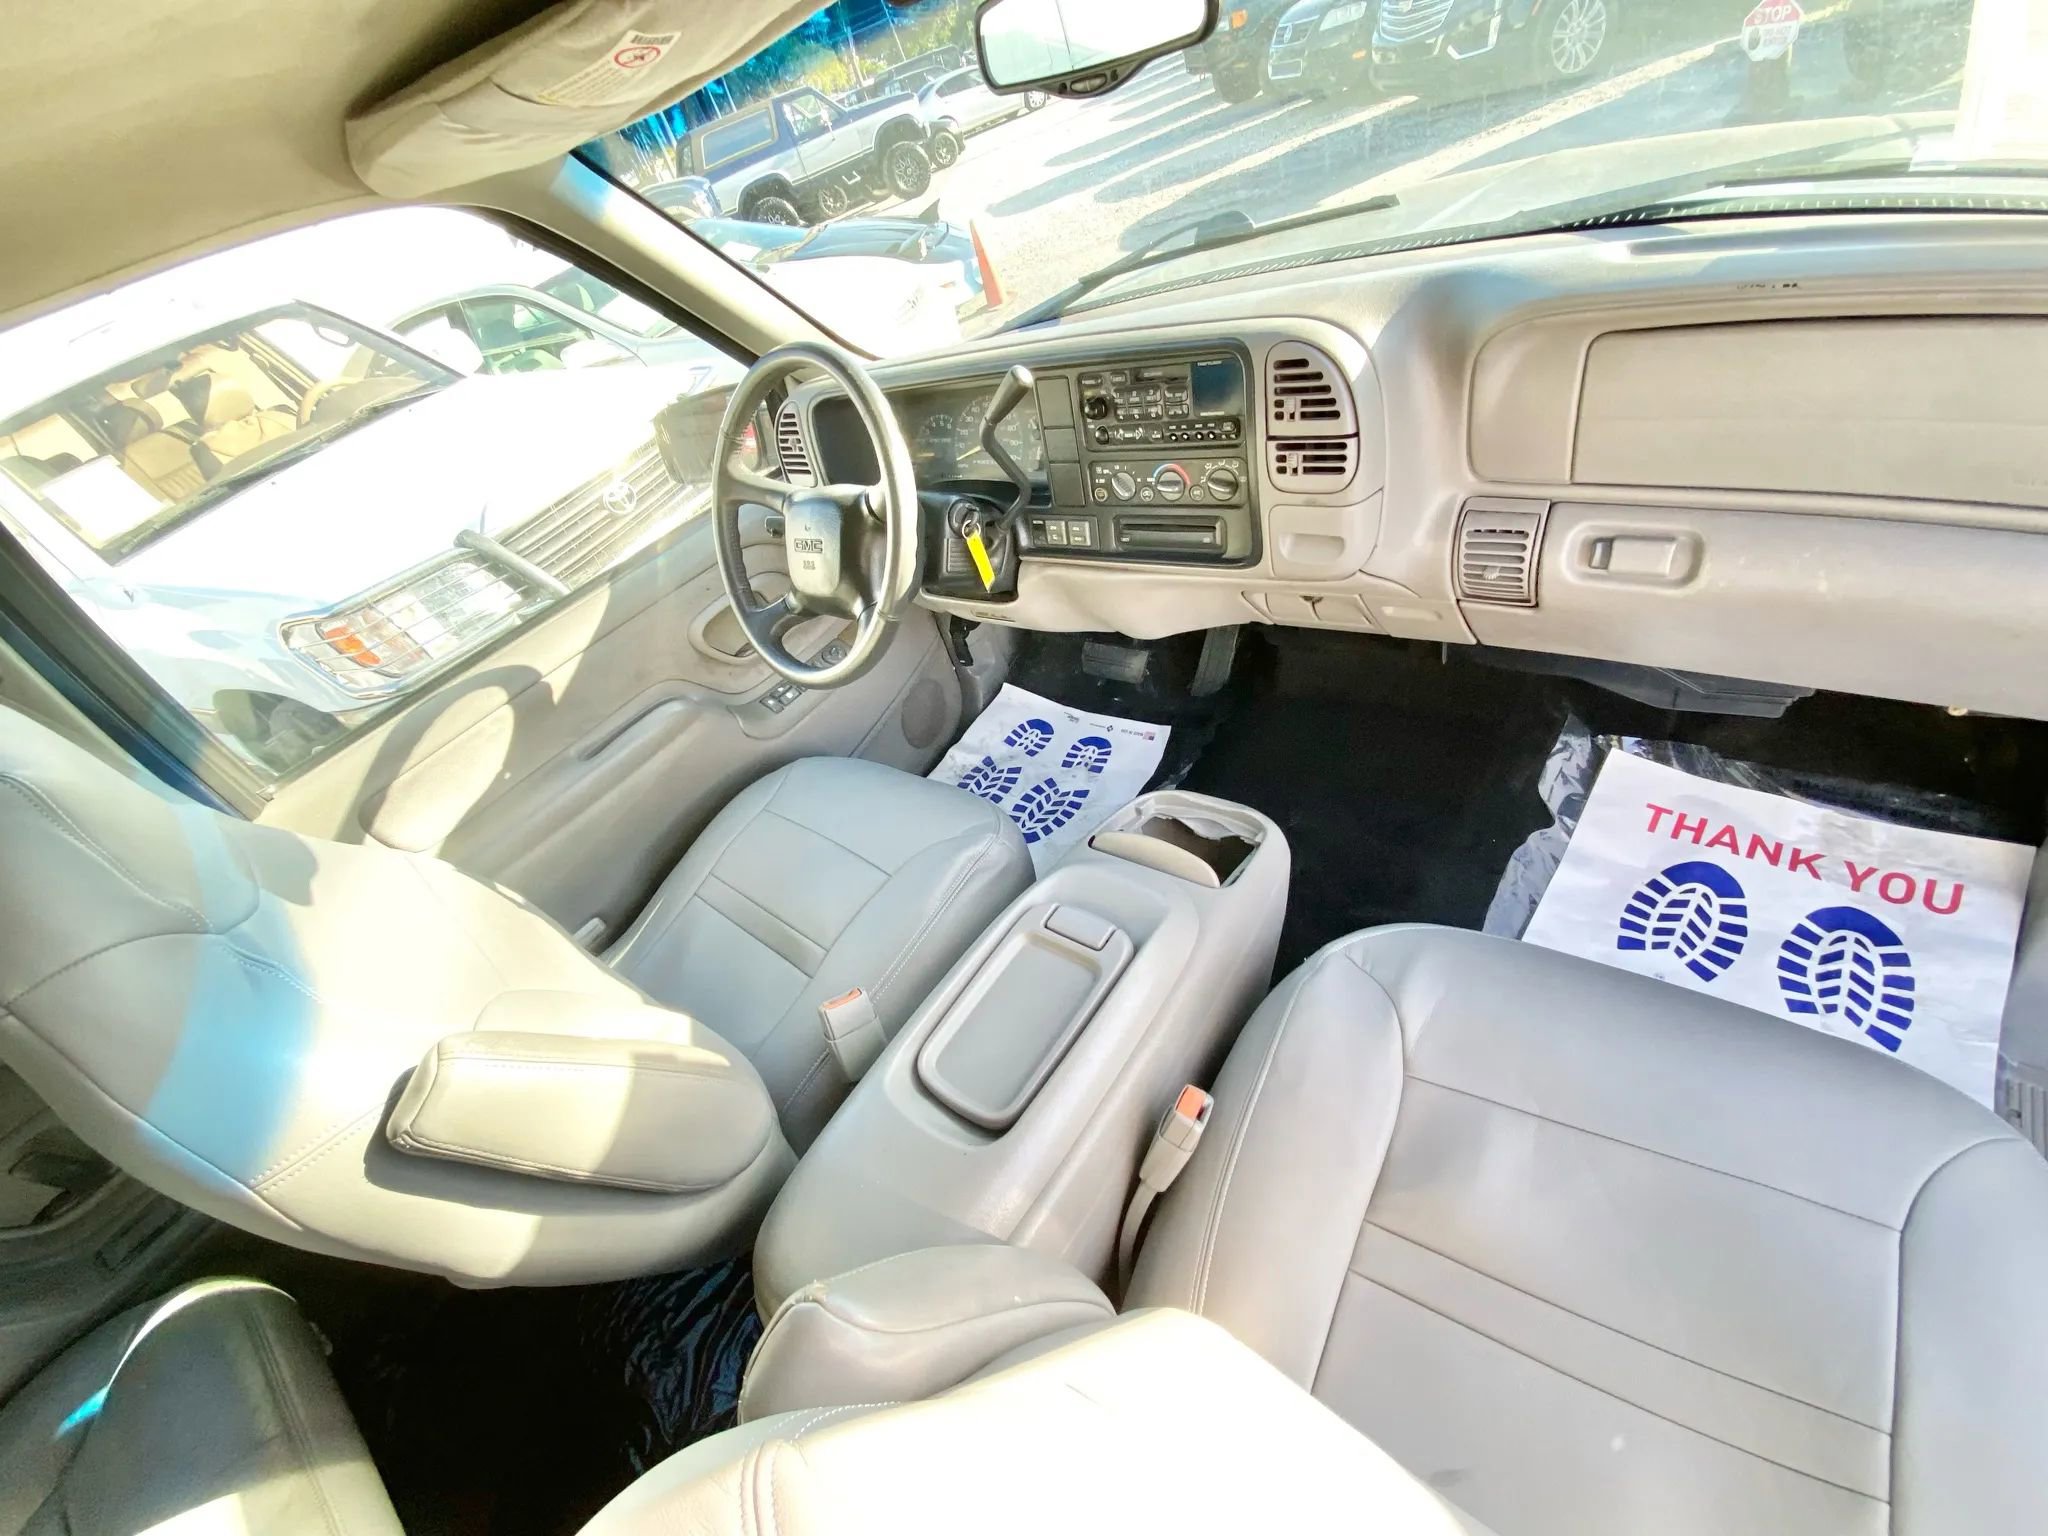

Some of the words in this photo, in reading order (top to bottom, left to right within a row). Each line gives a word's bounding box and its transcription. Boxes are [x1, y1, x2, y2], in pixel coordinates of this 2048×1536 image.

[1754, 5, 1792, 24] STOP
[794, 538, 823, 554] GMC
[1646, 803, 1825, 880] THANK
[1843, 860, 1965, 915] YOU
